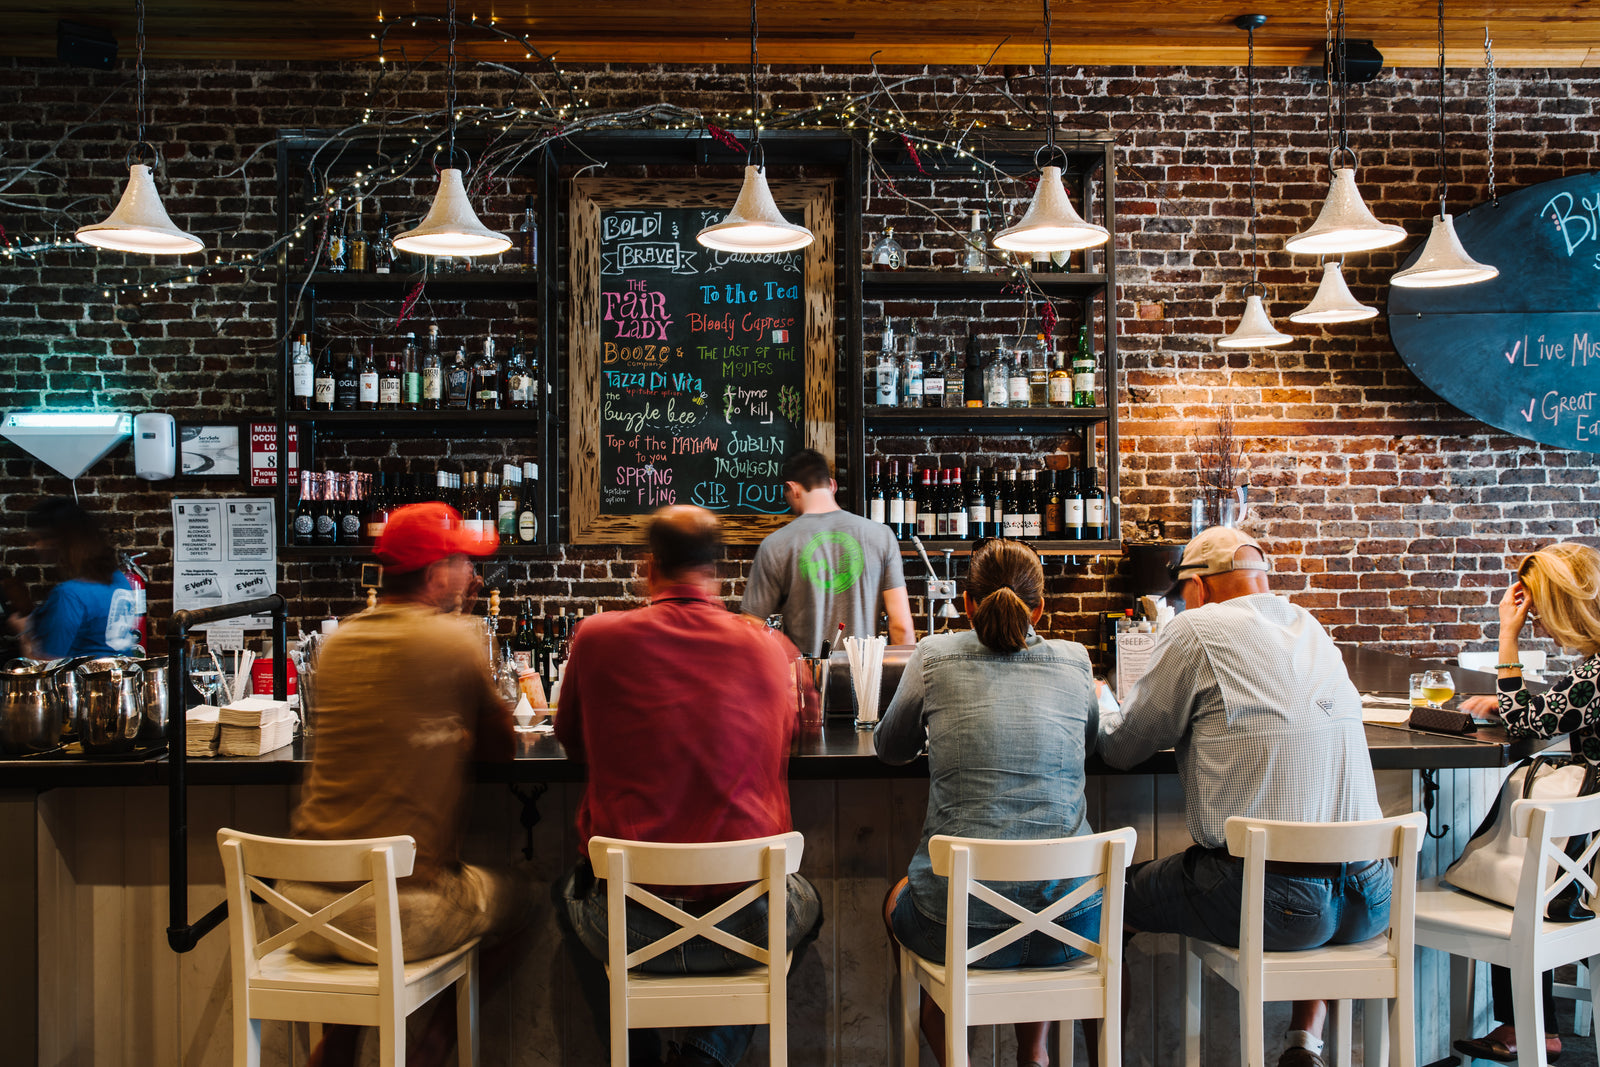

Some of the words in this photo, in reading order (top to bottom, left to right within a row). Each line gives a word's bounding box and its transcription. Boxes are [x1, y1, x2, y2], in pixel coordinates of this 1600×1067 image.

[604, 216, 658, 240] BOLD
[622, 246, 675, 266] BRAVE
[626, 279, 647, 292] THE
[699, 285, 720, 305] To
[725, 283, 758, 304] the
[763, 281, 799, 301] Tea
[685, 312, 736, 341] Bloody
[741, 311, 796, 341] Caprese
[675, 346, 684, 358] &
[696, 346, 719, 360] THE
[723, 345, 750, 359] LAST
[755, 346, 771, 359] OF
[776, 346, 797, 361] THE
[1523, 335, 1566, 367] Live
[627, 360, 664, 370] company
[722, 360, 774, 378] MOJITOS
[603, 370, 646, 388] Tazza
[650, 371, 668, 391] Di
[672, 372, 703, 393] Vita
[605, 392, 621, 400] the
[667, 397, 697, 424] bee
[751, 401, 768, 416] kill
[1541, 390, 1597, 426] Great
[1577, 414, 1600, 441] Ea
[605, 434, 626, 453] Top
[628, 434, 641, 449] of
[644, 435, 667, 451] the
[671, 436, 719, 455] MAYHAW
[636, 451, 646, 464] to
[649, 454, 667, 466] you
[691, 480, 730, 507] SIR
[737, 482, 790, 511] LOUI
